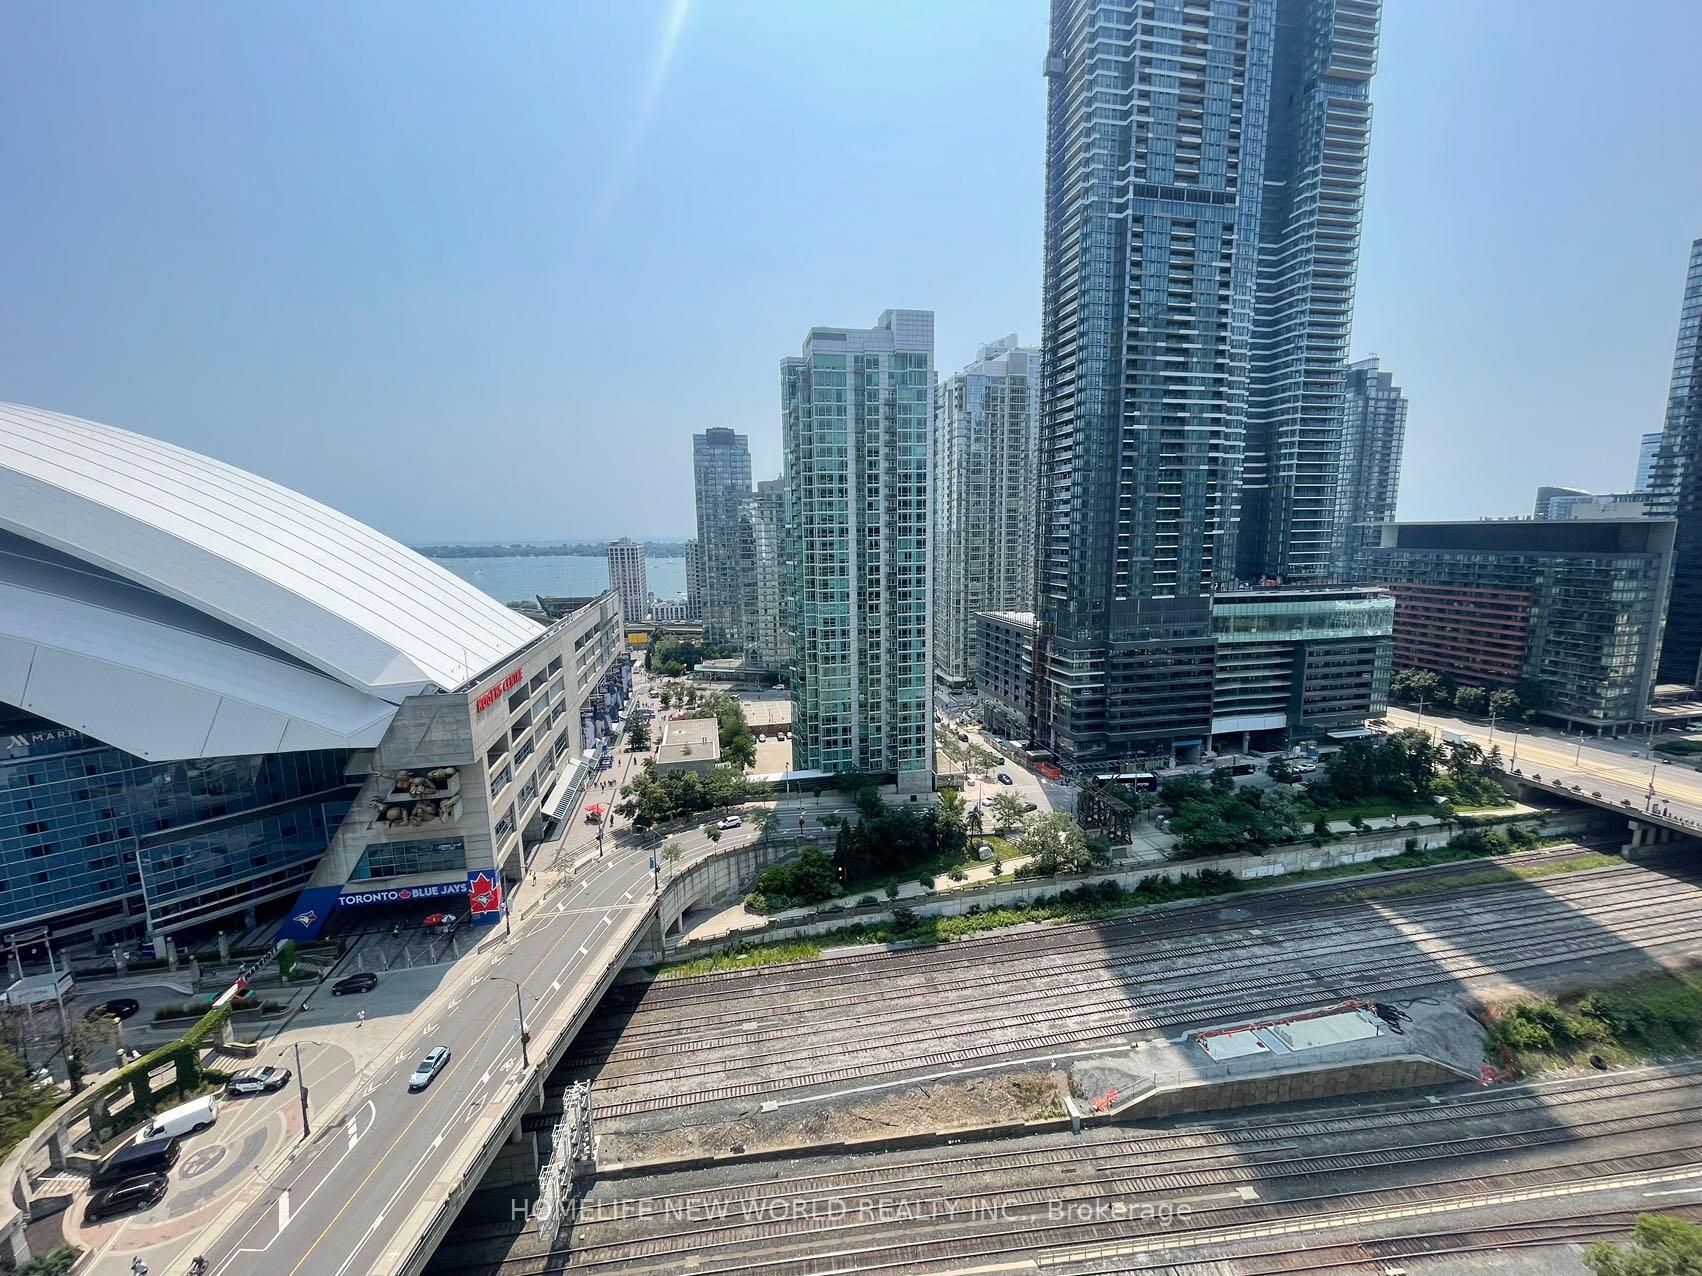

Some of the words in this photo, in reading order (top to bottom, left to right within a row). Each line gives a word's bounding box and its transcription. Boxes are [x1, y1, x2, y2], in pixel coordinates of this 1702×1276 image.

[338, 891, 398, 906] TORONTO
[412, 886, 439, 898] BLUE
[441, 883, 467, 895] JAYS
